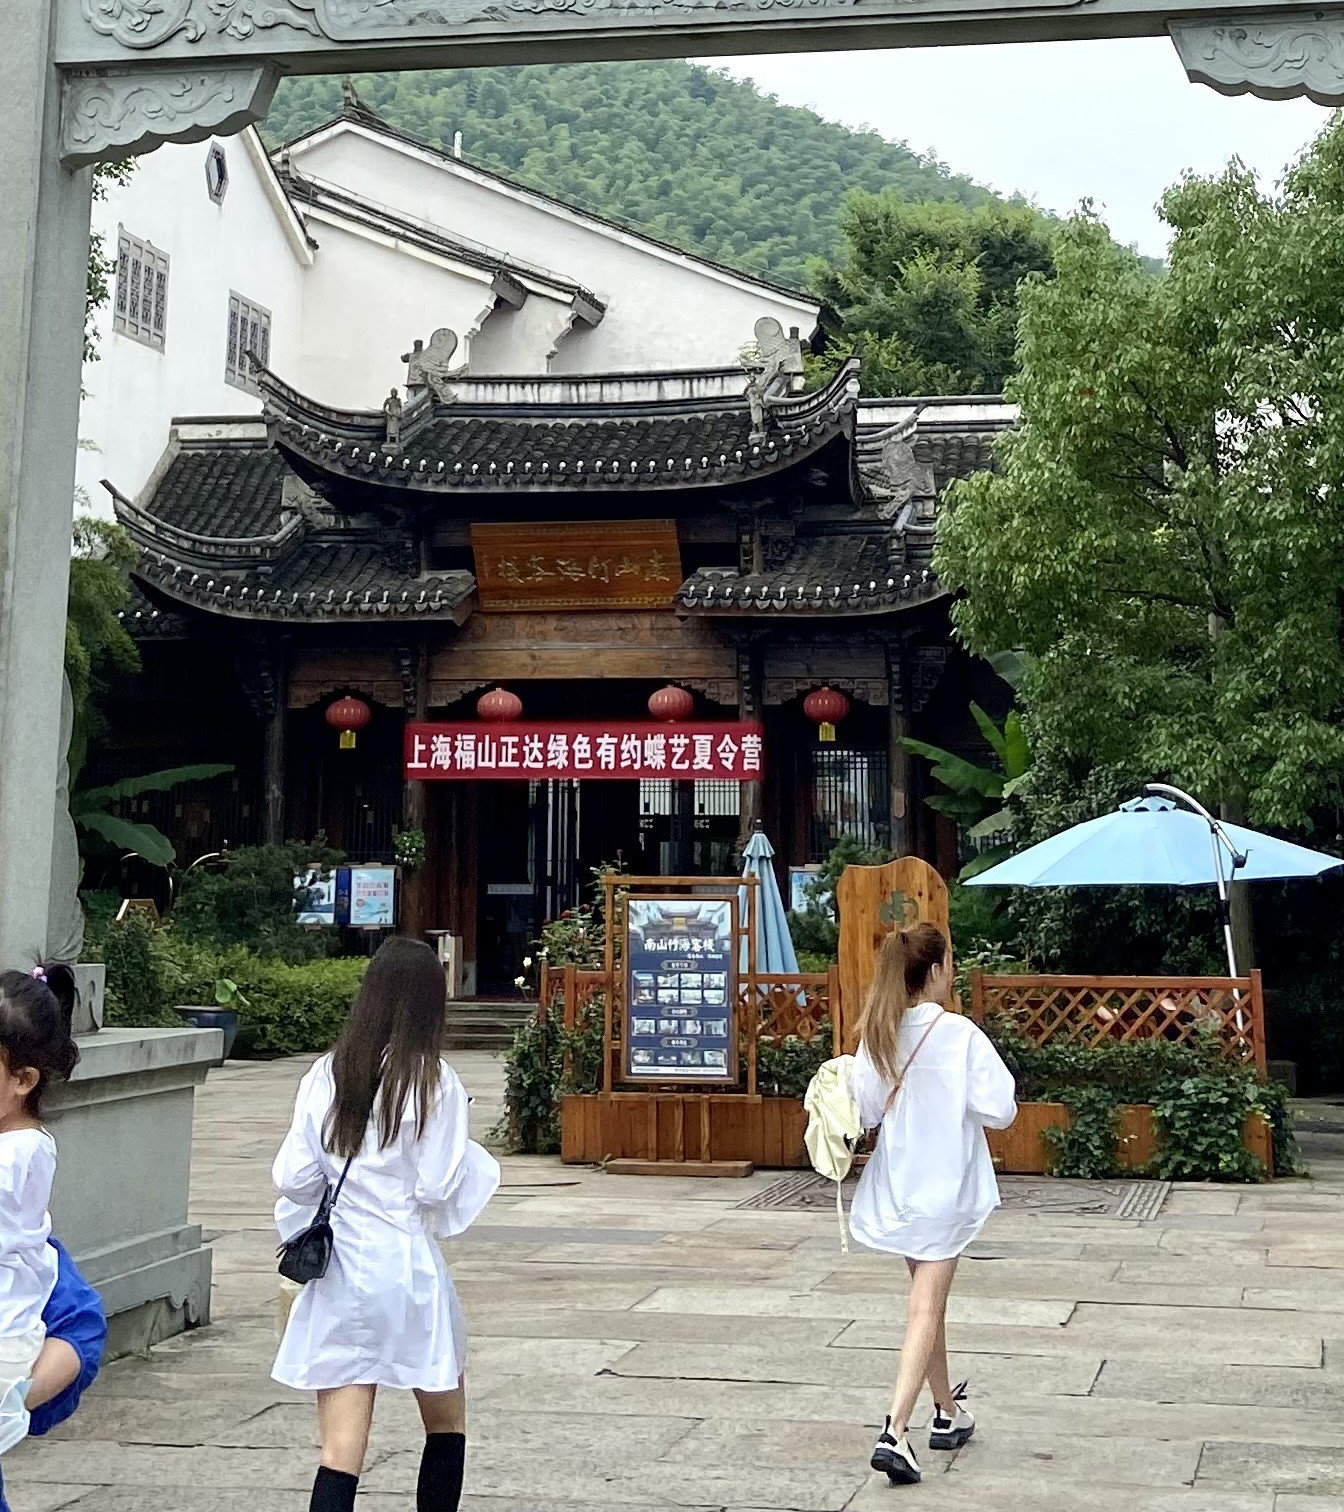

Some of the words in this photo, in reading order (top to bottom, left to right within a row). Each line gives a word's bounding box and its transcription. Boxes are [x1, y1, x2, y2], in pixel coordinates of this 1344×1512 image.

[406, 732, 763, 772] 上海福山正达绿色有约蝶艺夏令营
